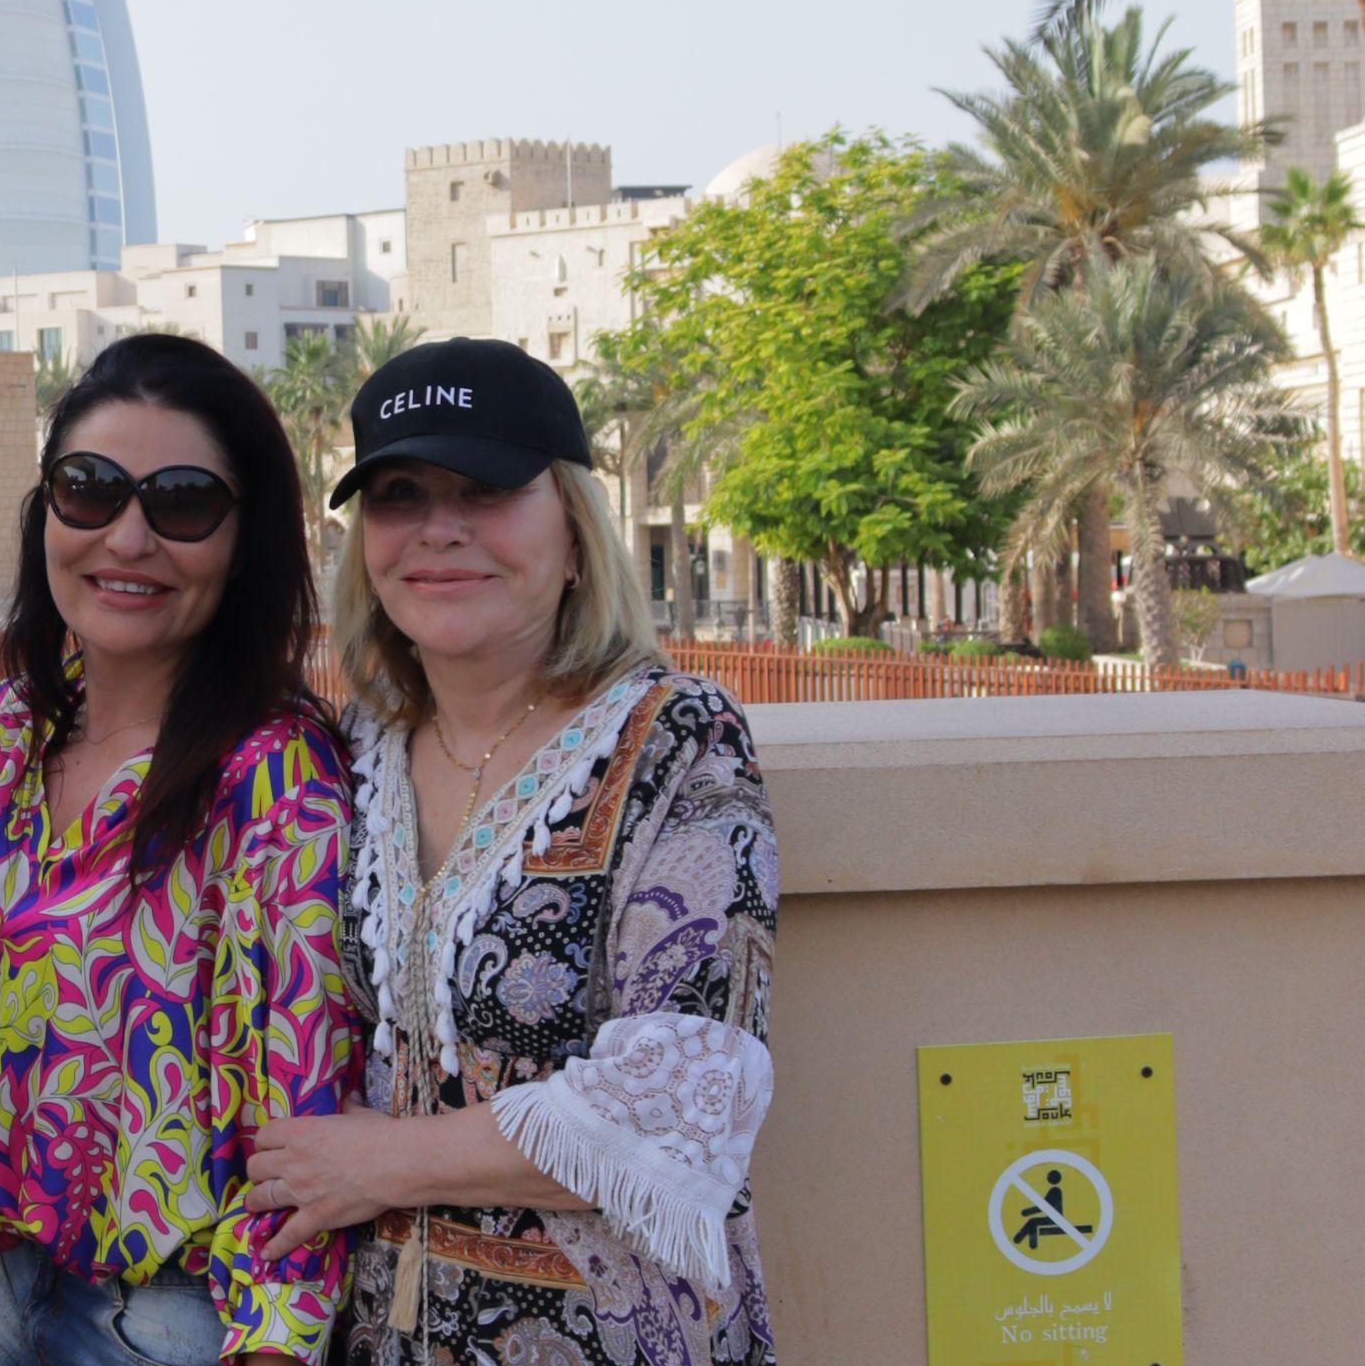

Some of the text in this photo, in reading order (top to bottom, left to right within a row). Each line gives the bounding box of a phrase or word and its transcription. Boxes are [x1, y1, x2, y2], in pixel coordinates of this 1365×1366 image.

[379, 385, 474, 419] CELINE
[1103, 1290, 1113, 1310] لا
[1001, 1322, 1108, 1344] No sitting
